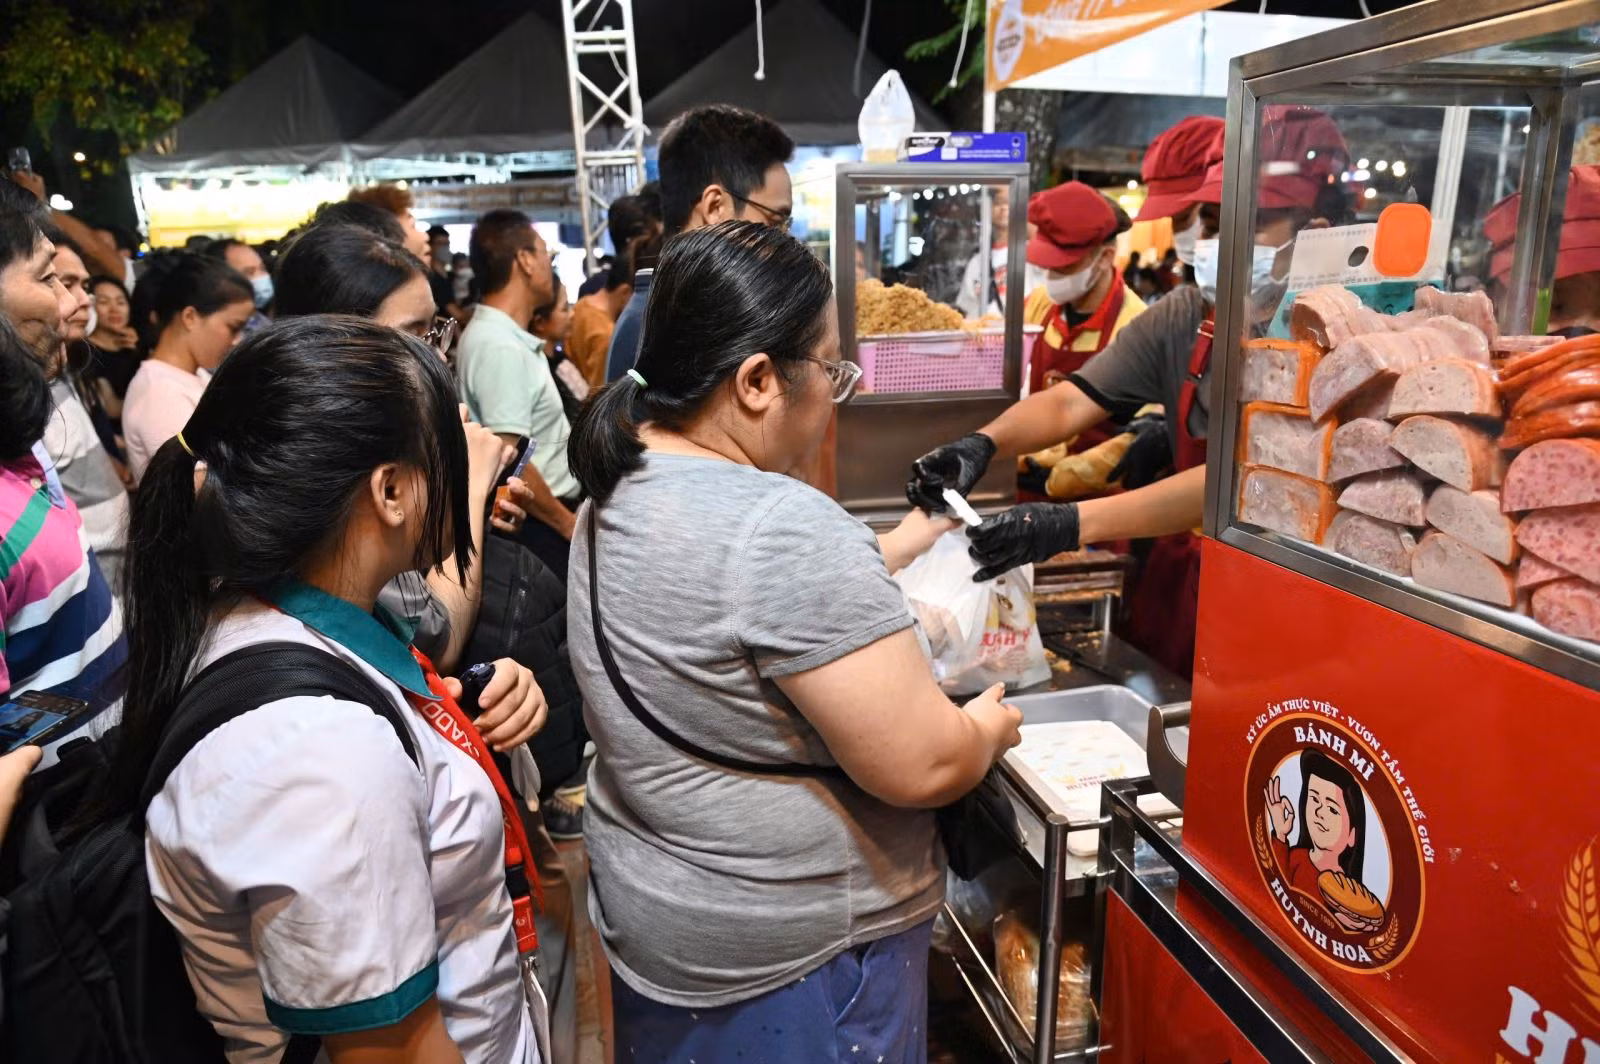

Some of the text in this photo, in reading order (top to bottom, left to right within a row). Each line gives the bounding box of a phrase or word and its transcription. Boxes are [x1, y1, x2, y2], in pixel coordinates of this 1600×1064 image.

[1282, 697, 1310, 712] THỰC
[1312, 700, 1339, 718] VIỆT
[1348, 716, 1380, 751] VƯƠN
[1293, 722, 1375, 781] BÁNH MÌ
[1331, 939, 1372, 962] HOA
